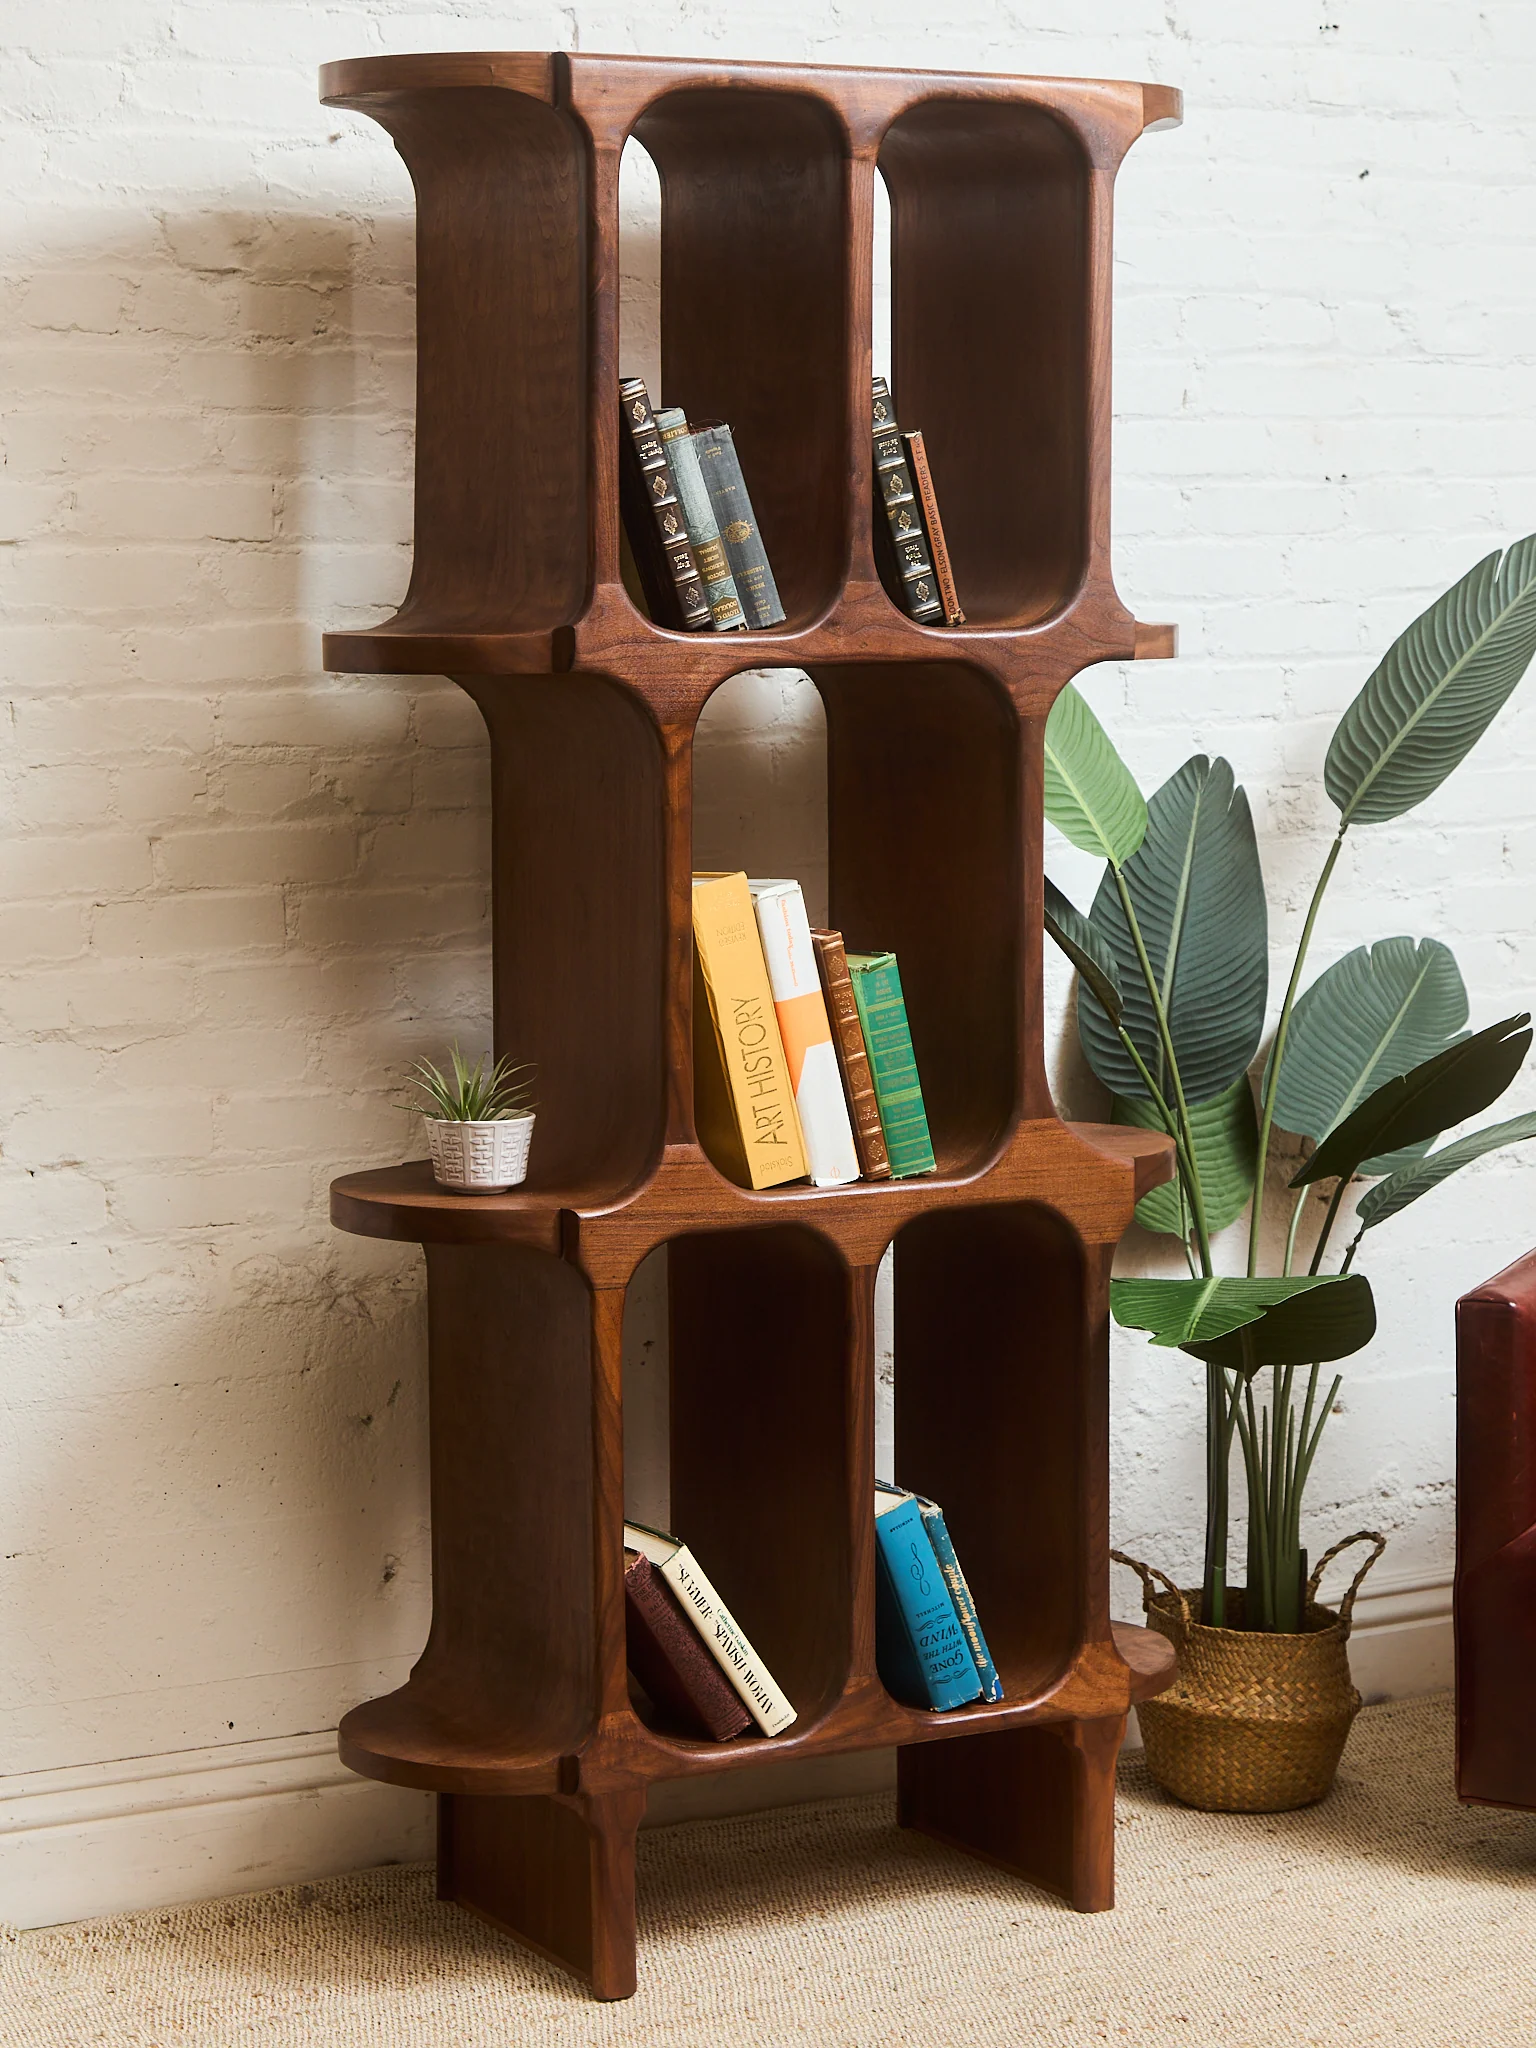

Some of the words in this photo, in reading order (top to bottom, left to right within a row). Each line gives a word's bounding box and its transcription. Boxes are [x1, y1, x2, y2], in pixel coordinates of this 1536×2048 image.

[663, 426, 688, 439] COLLIER
[920, 465, 932, 501] READERS
[926, 502, 938, 525] BASIC
[707, 570, 726, 580] DOCTOR
[943, 577, 952, 595] TWO
[713, 600, 737, 614] DOUGLAS
[722, 608, 740, 620] LLOYD
[716, 921, 745, 937] EDITION
[718, 933, 747, 947] REVISED
[731, 997, 778, 1099] HISTORY
[752, 1103, 788, 1145] ART
[759, 1156, 794, 1176] Stokstad
[889, 1517, 913, 1533] MACMILLAN
[678, 1567, 713, 1620] SUMMER
[916, 1602, 945, 1619] MITCHELL
[716, 1608, 735, 1637] Catherine
[735, 1634, 749, 1656] Gaskin
[919, 1623, 958, 1647] WIND
[955, 1594, 982, 1657] moonflower
[923, 1648, 941, 1661] THE
[942, 1638, 963, 1657] WITH
[713, 1623, 747, 1671] SPANISH
[743, 1669, 776, 1714] WOMAN
[930, 1649, 964, 1674] GONE
[976, 1656, 989, 1668] the
